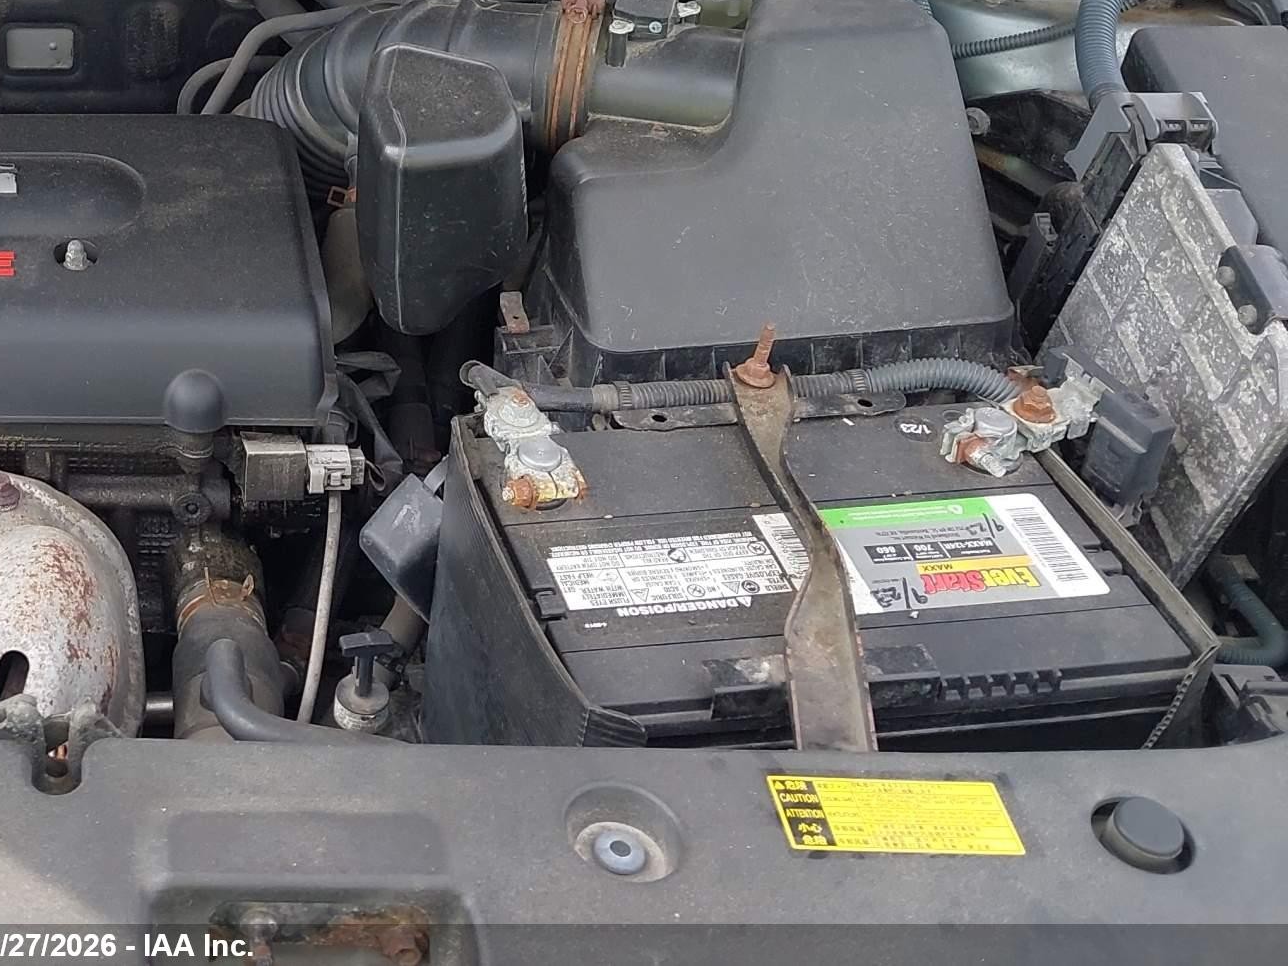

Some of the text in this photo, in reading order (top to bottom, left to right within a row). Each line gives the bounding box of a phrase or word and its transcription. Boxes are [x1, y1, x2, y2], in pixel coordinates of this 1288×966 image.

[900, 423, 932, 435] 1/23
[913, 544, 934, 552] 700
[921, 563, 954, 572] MAXX
[920, 567, 1041, 595] EverStart
[616, 597, 738, 617] DANGER/POISON
[779, 793, 820, 803] CAUTION
[785, 808, 825, 818] ATTENTION
